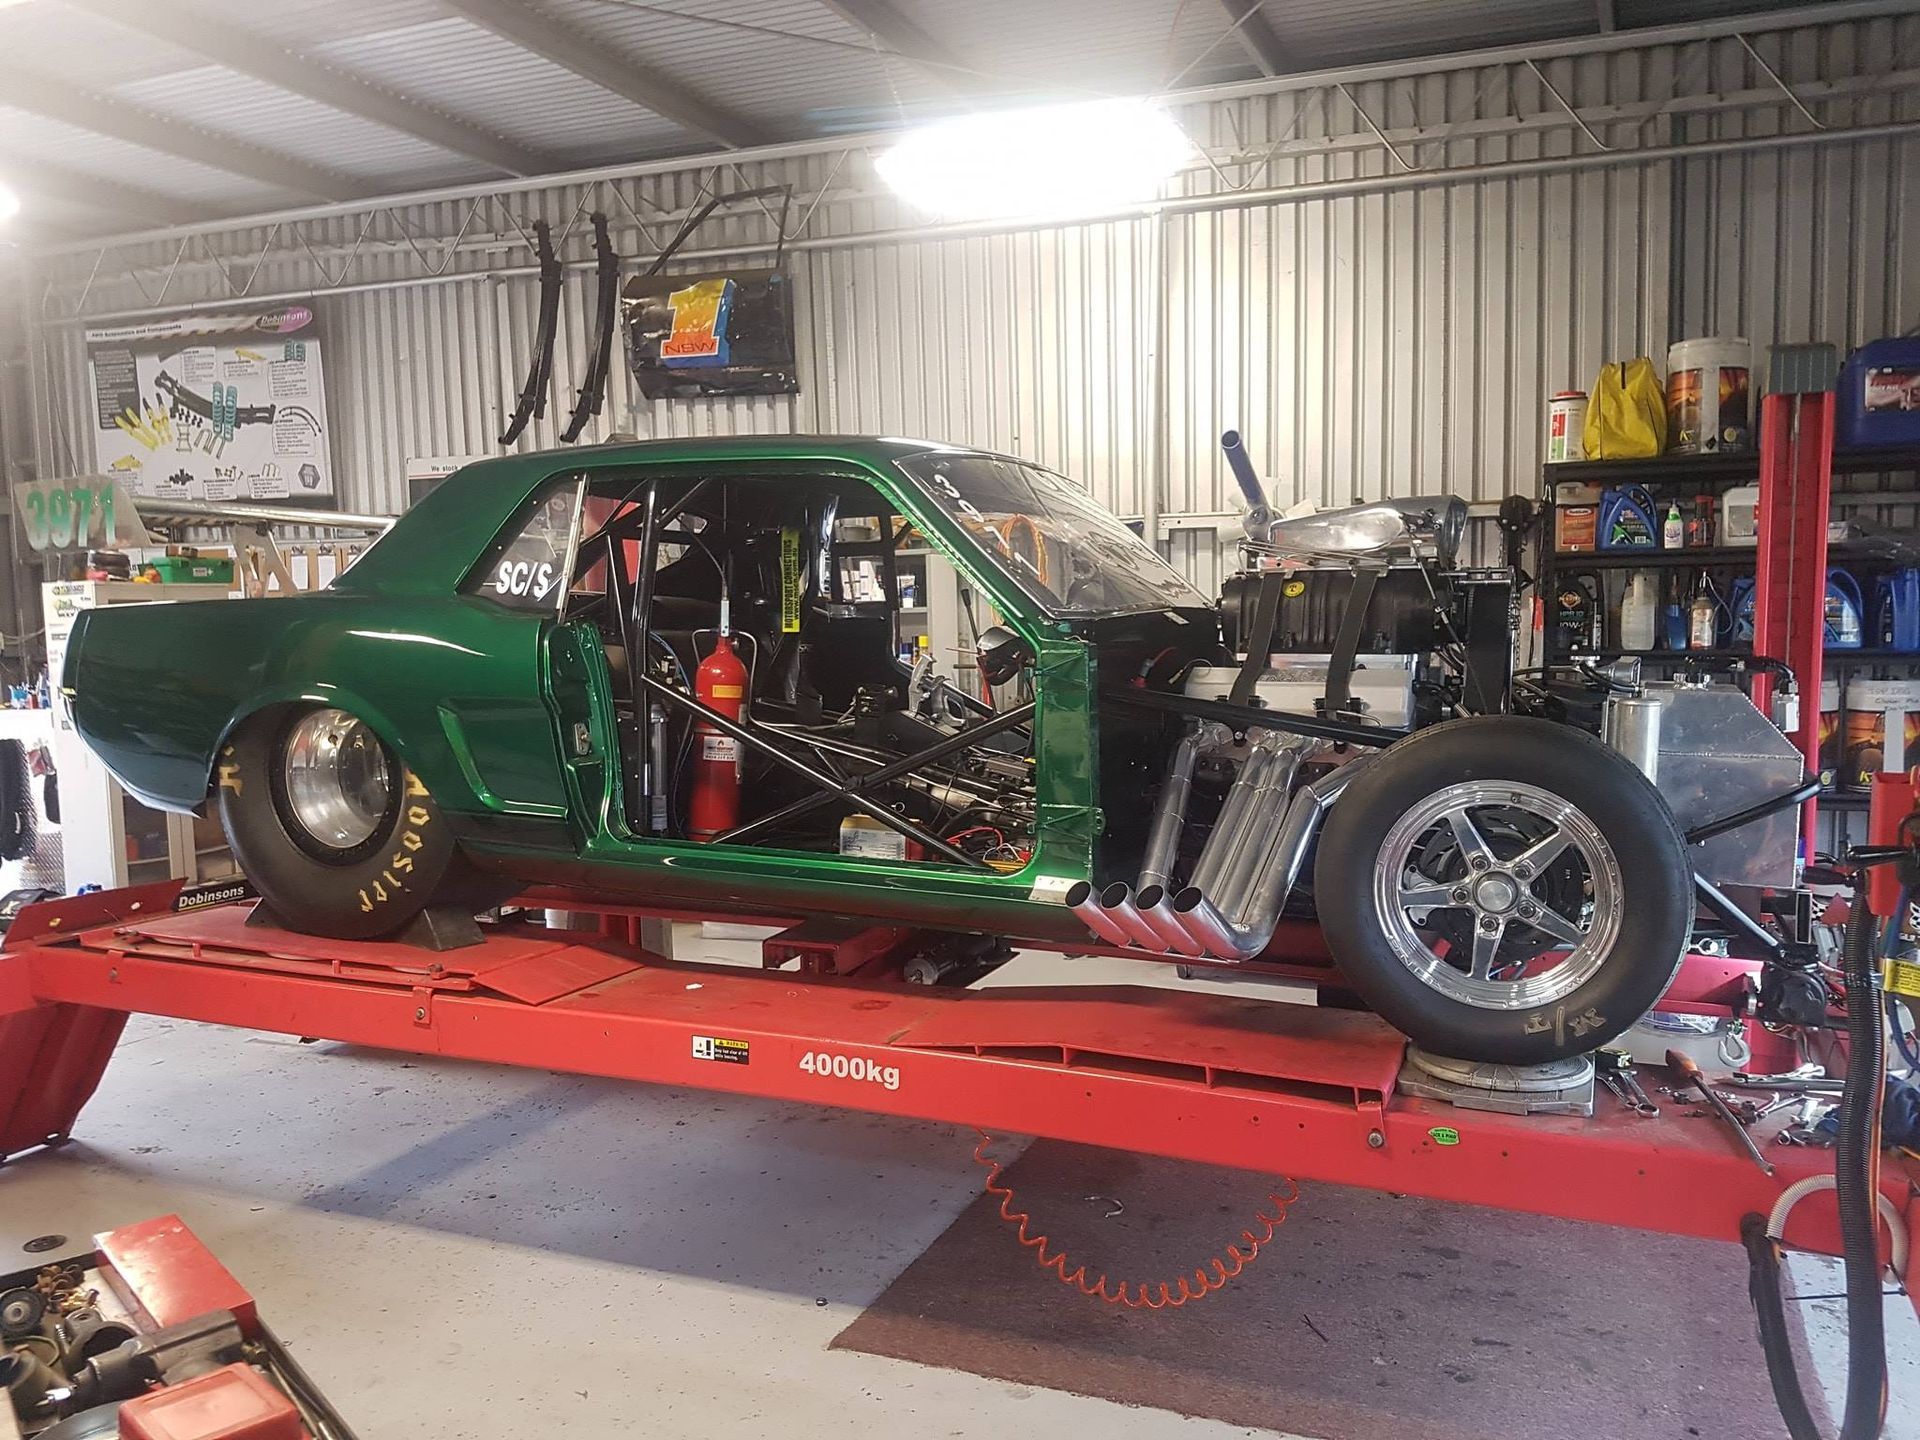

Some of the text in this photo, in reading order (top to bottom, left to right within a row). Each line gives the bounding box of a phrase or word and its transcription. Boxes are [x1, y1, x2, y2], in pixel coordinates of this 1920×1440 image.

[665, 342, 715, 355] NSW
[26, 482, 117, 551] 3971
[934, 474, 1041, 575] 3971
[496, 560, 552, 598] SC/S
[179, 886, 245, 908] Dobinsons
[799, 1051, 900, 1090] 4000kg
